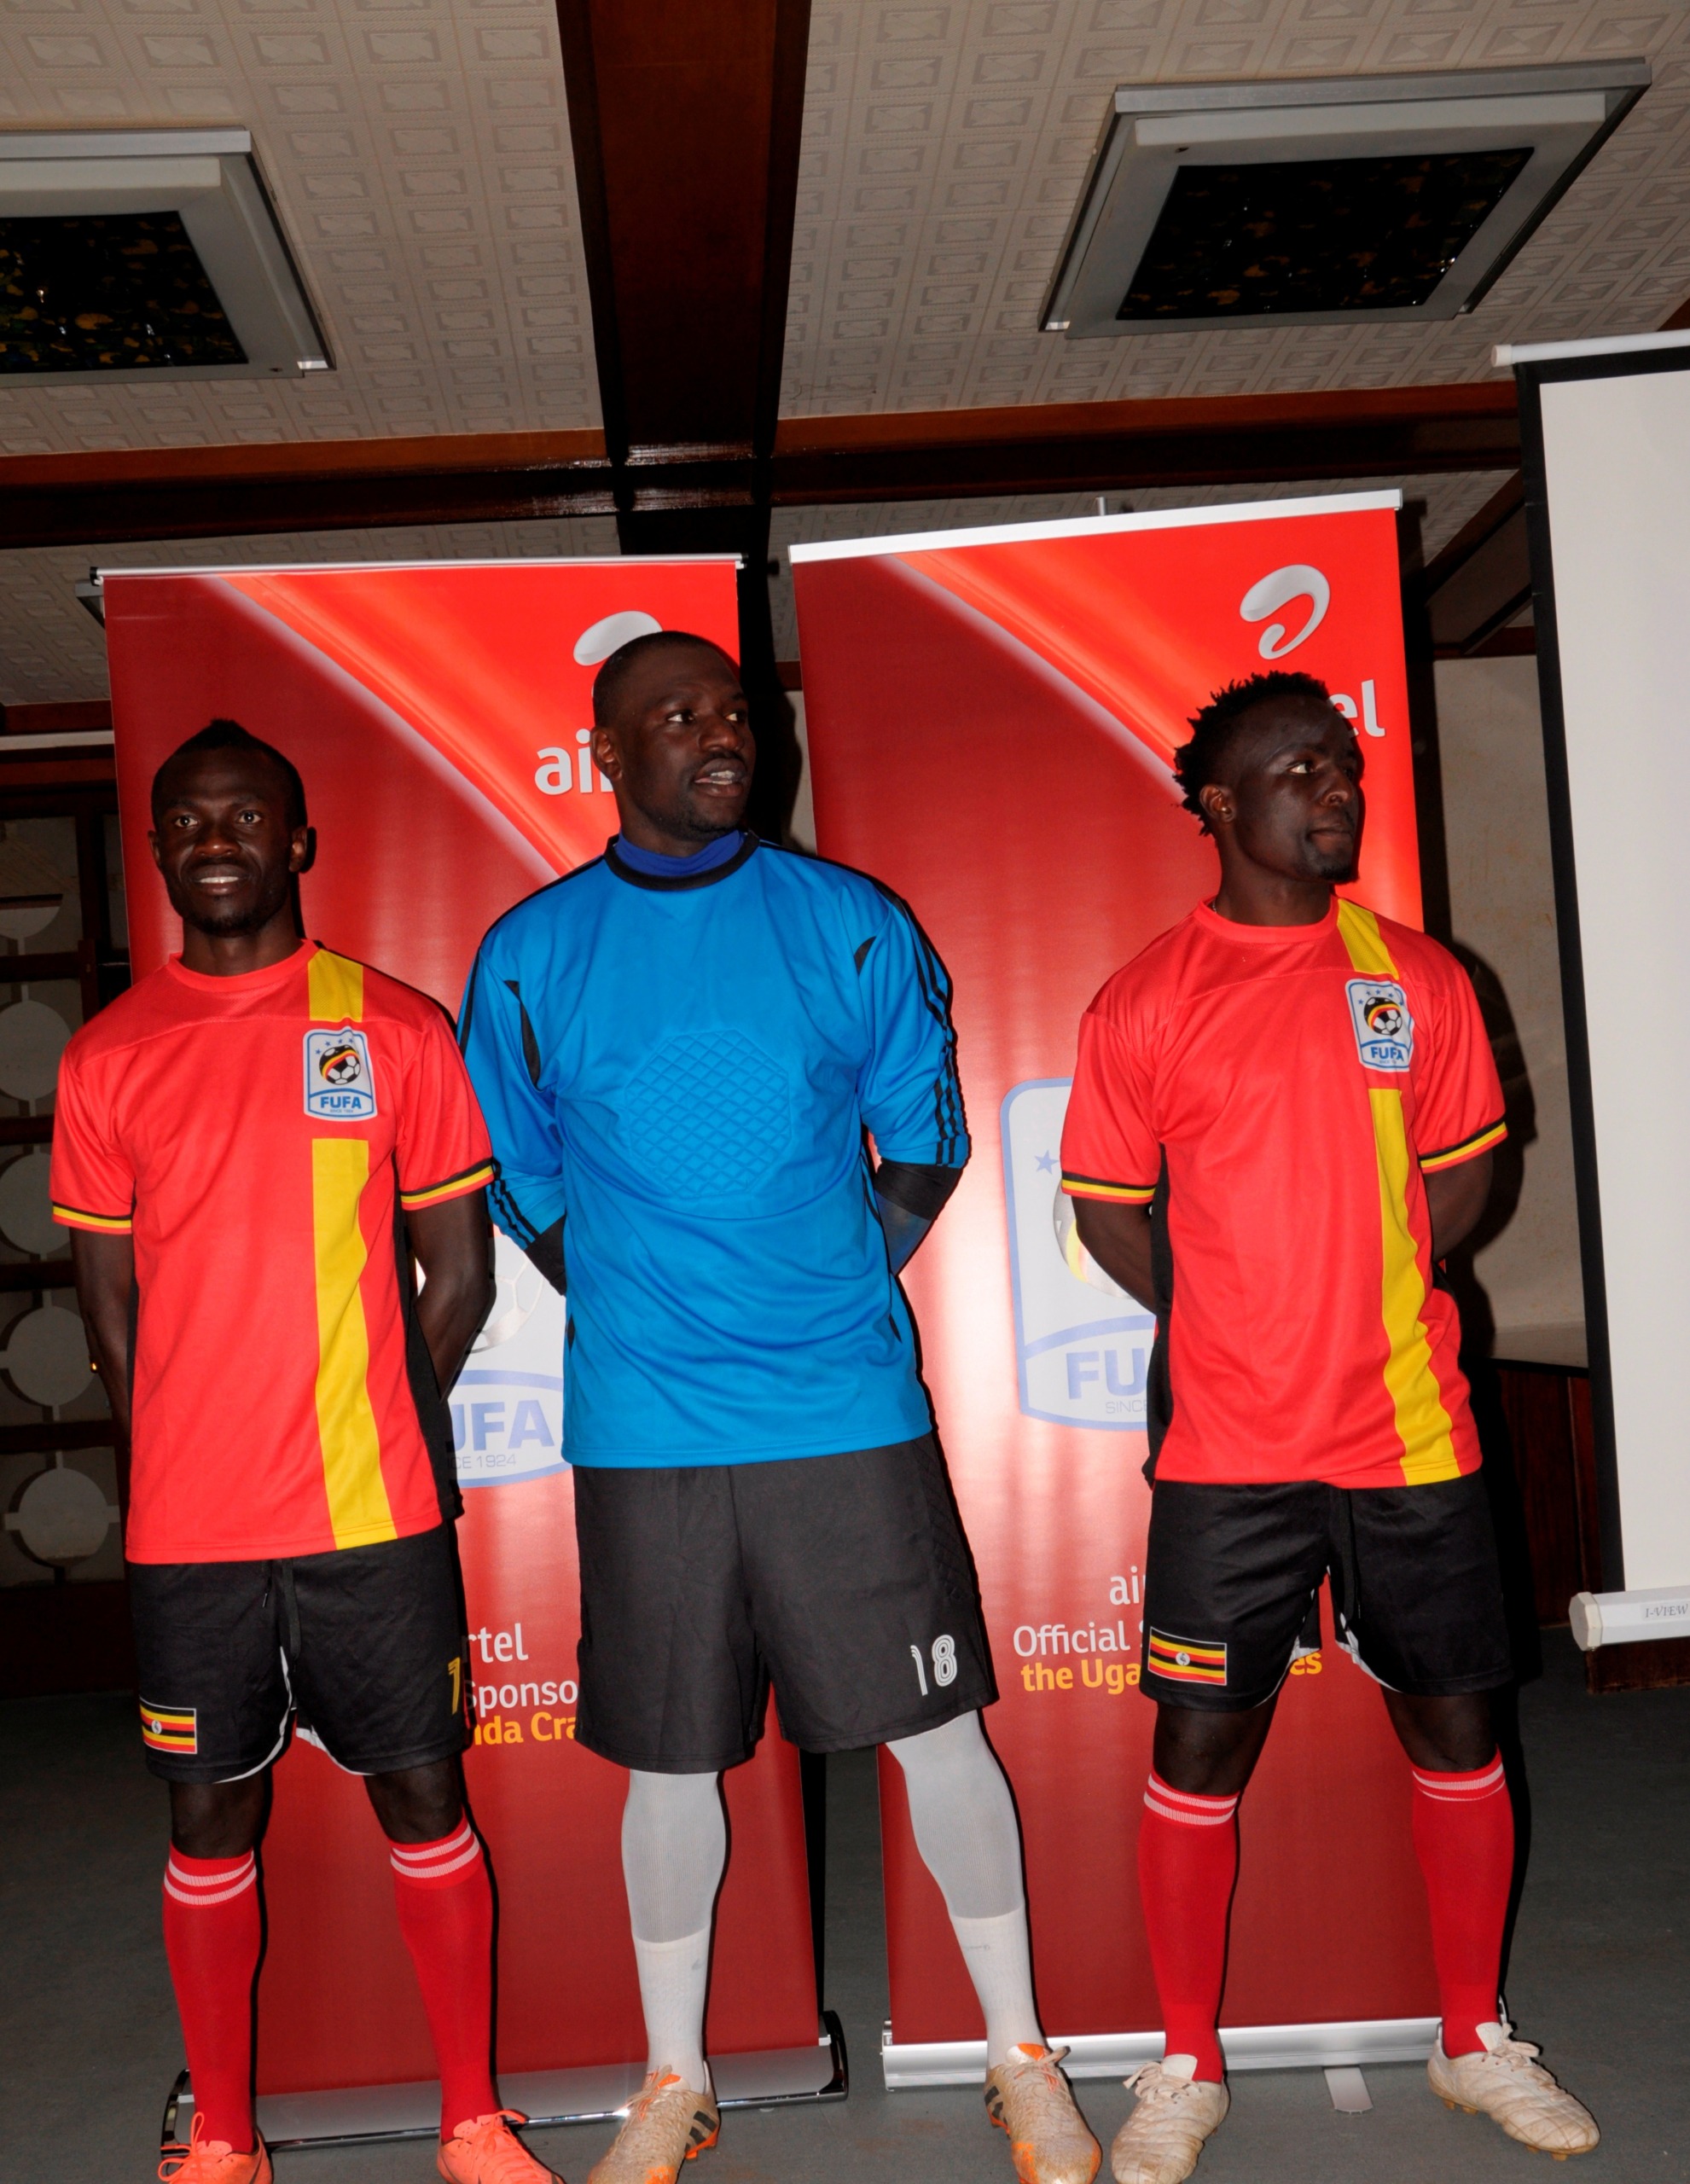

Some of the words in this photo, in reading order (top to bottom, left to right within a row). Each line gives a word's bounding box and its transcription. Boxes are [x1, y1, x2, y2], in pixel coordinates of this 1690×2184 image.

[534, 729, 612, 796] ai
[1370, 1047, 1404, 1061] FUFA
[320, 1095, 362, 1109] FUFA
[476, 1453, 517, 1468] 1924
[1109, 1565, 1147, 1606] ai
[1013, 1620, 1131, 1657] Official
[909, 1634, 957, 1696] 18
[1020, 1663, 1073, 1692] the
